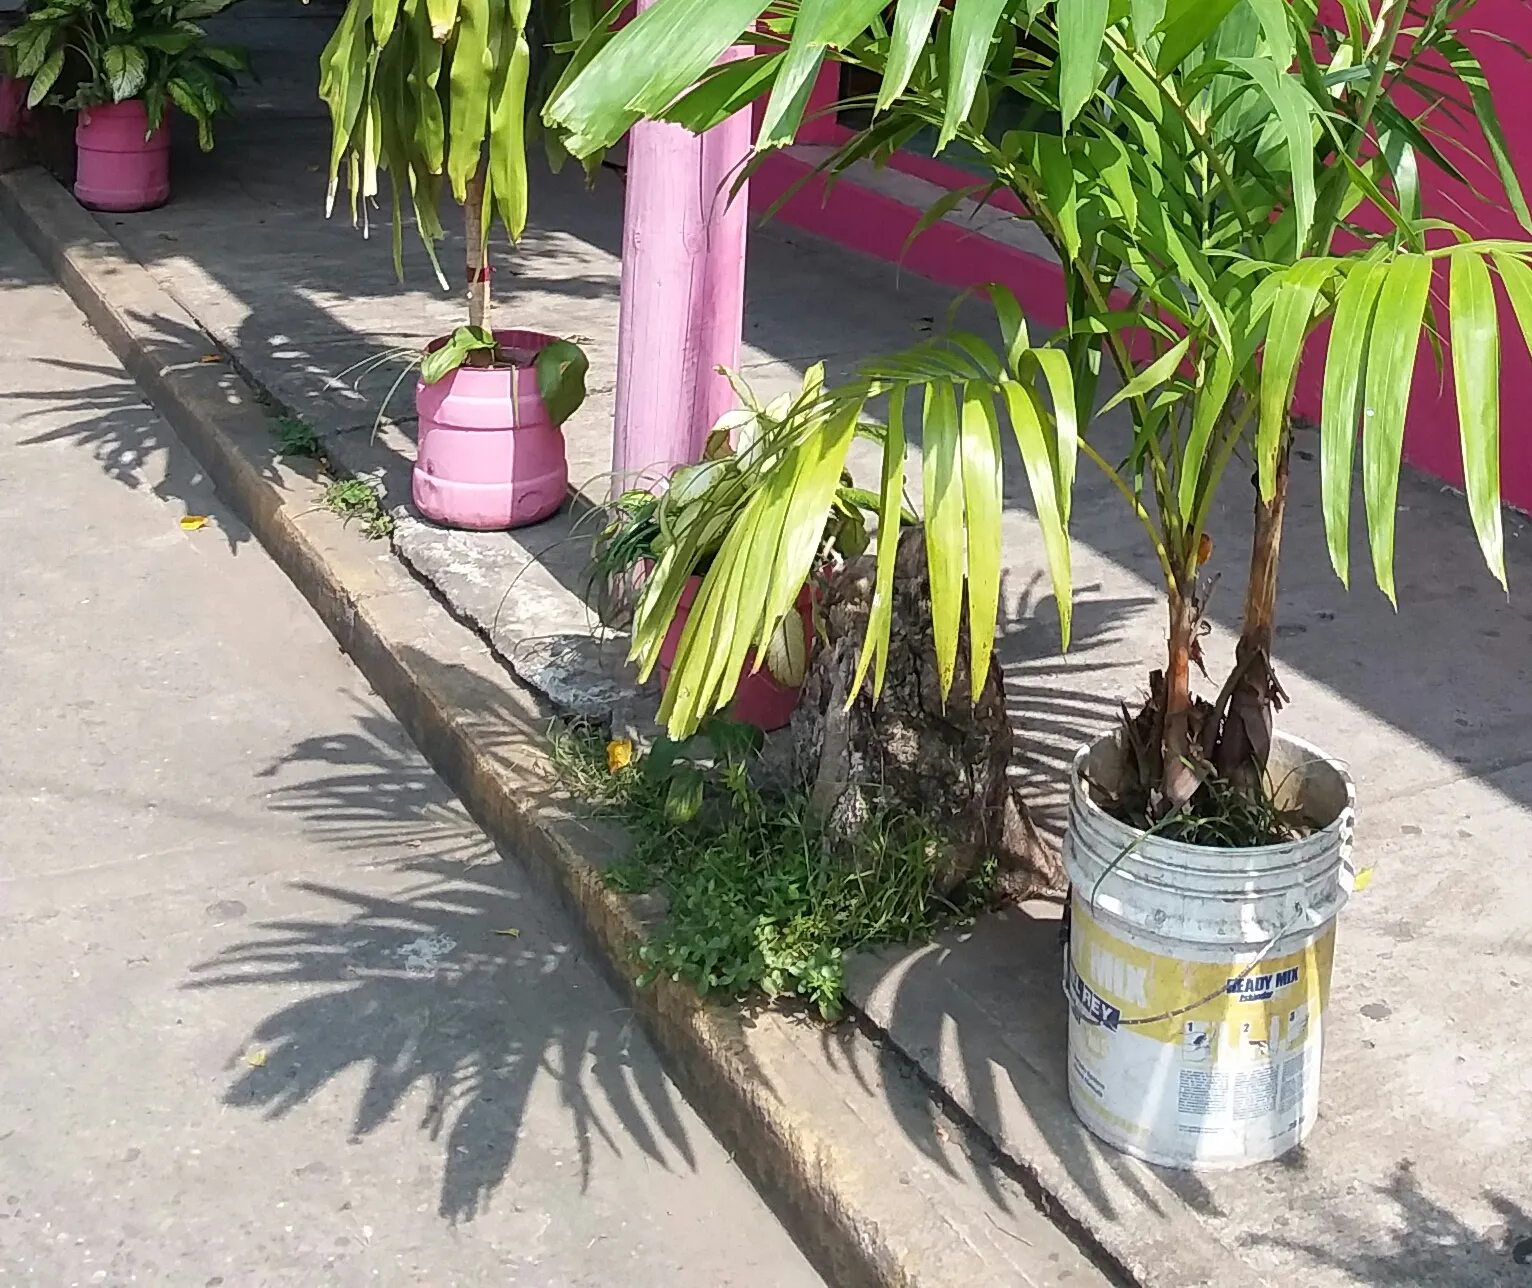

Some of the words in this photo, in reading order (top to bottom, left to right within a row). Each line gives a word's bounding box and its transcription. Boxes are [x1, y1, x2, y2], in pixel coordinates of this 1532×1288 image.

[1275, 967, 1298, 987] MIX
[1082, 984, 1113, 1020] REY
[1243, 1023, 1250, 1032] 2
